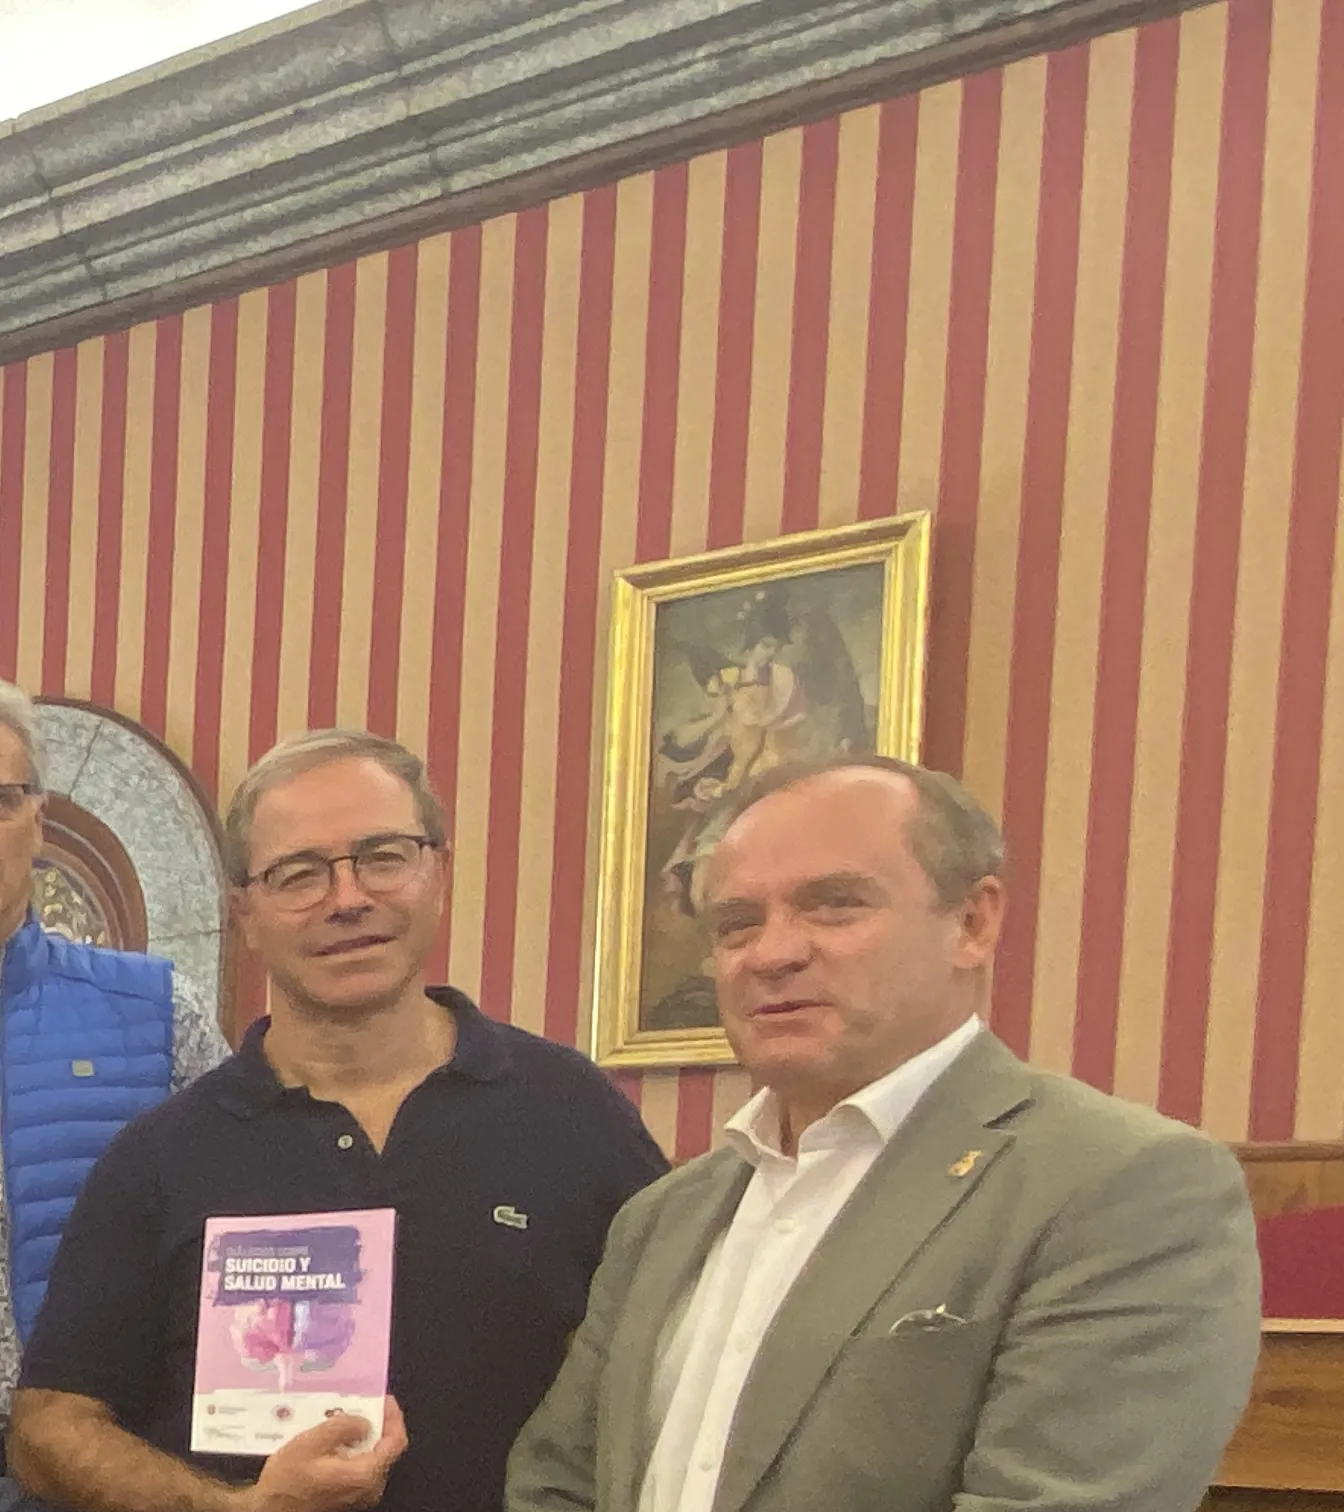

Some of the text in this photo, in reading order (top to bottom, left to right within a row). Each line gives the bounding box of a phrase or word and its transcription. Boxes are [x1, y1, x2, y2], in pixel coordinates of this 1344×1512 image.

[224, 1256, 312, 1273] SUICIDIO Y
[223, 1272, 346, 1291] SALUD MENTAL
